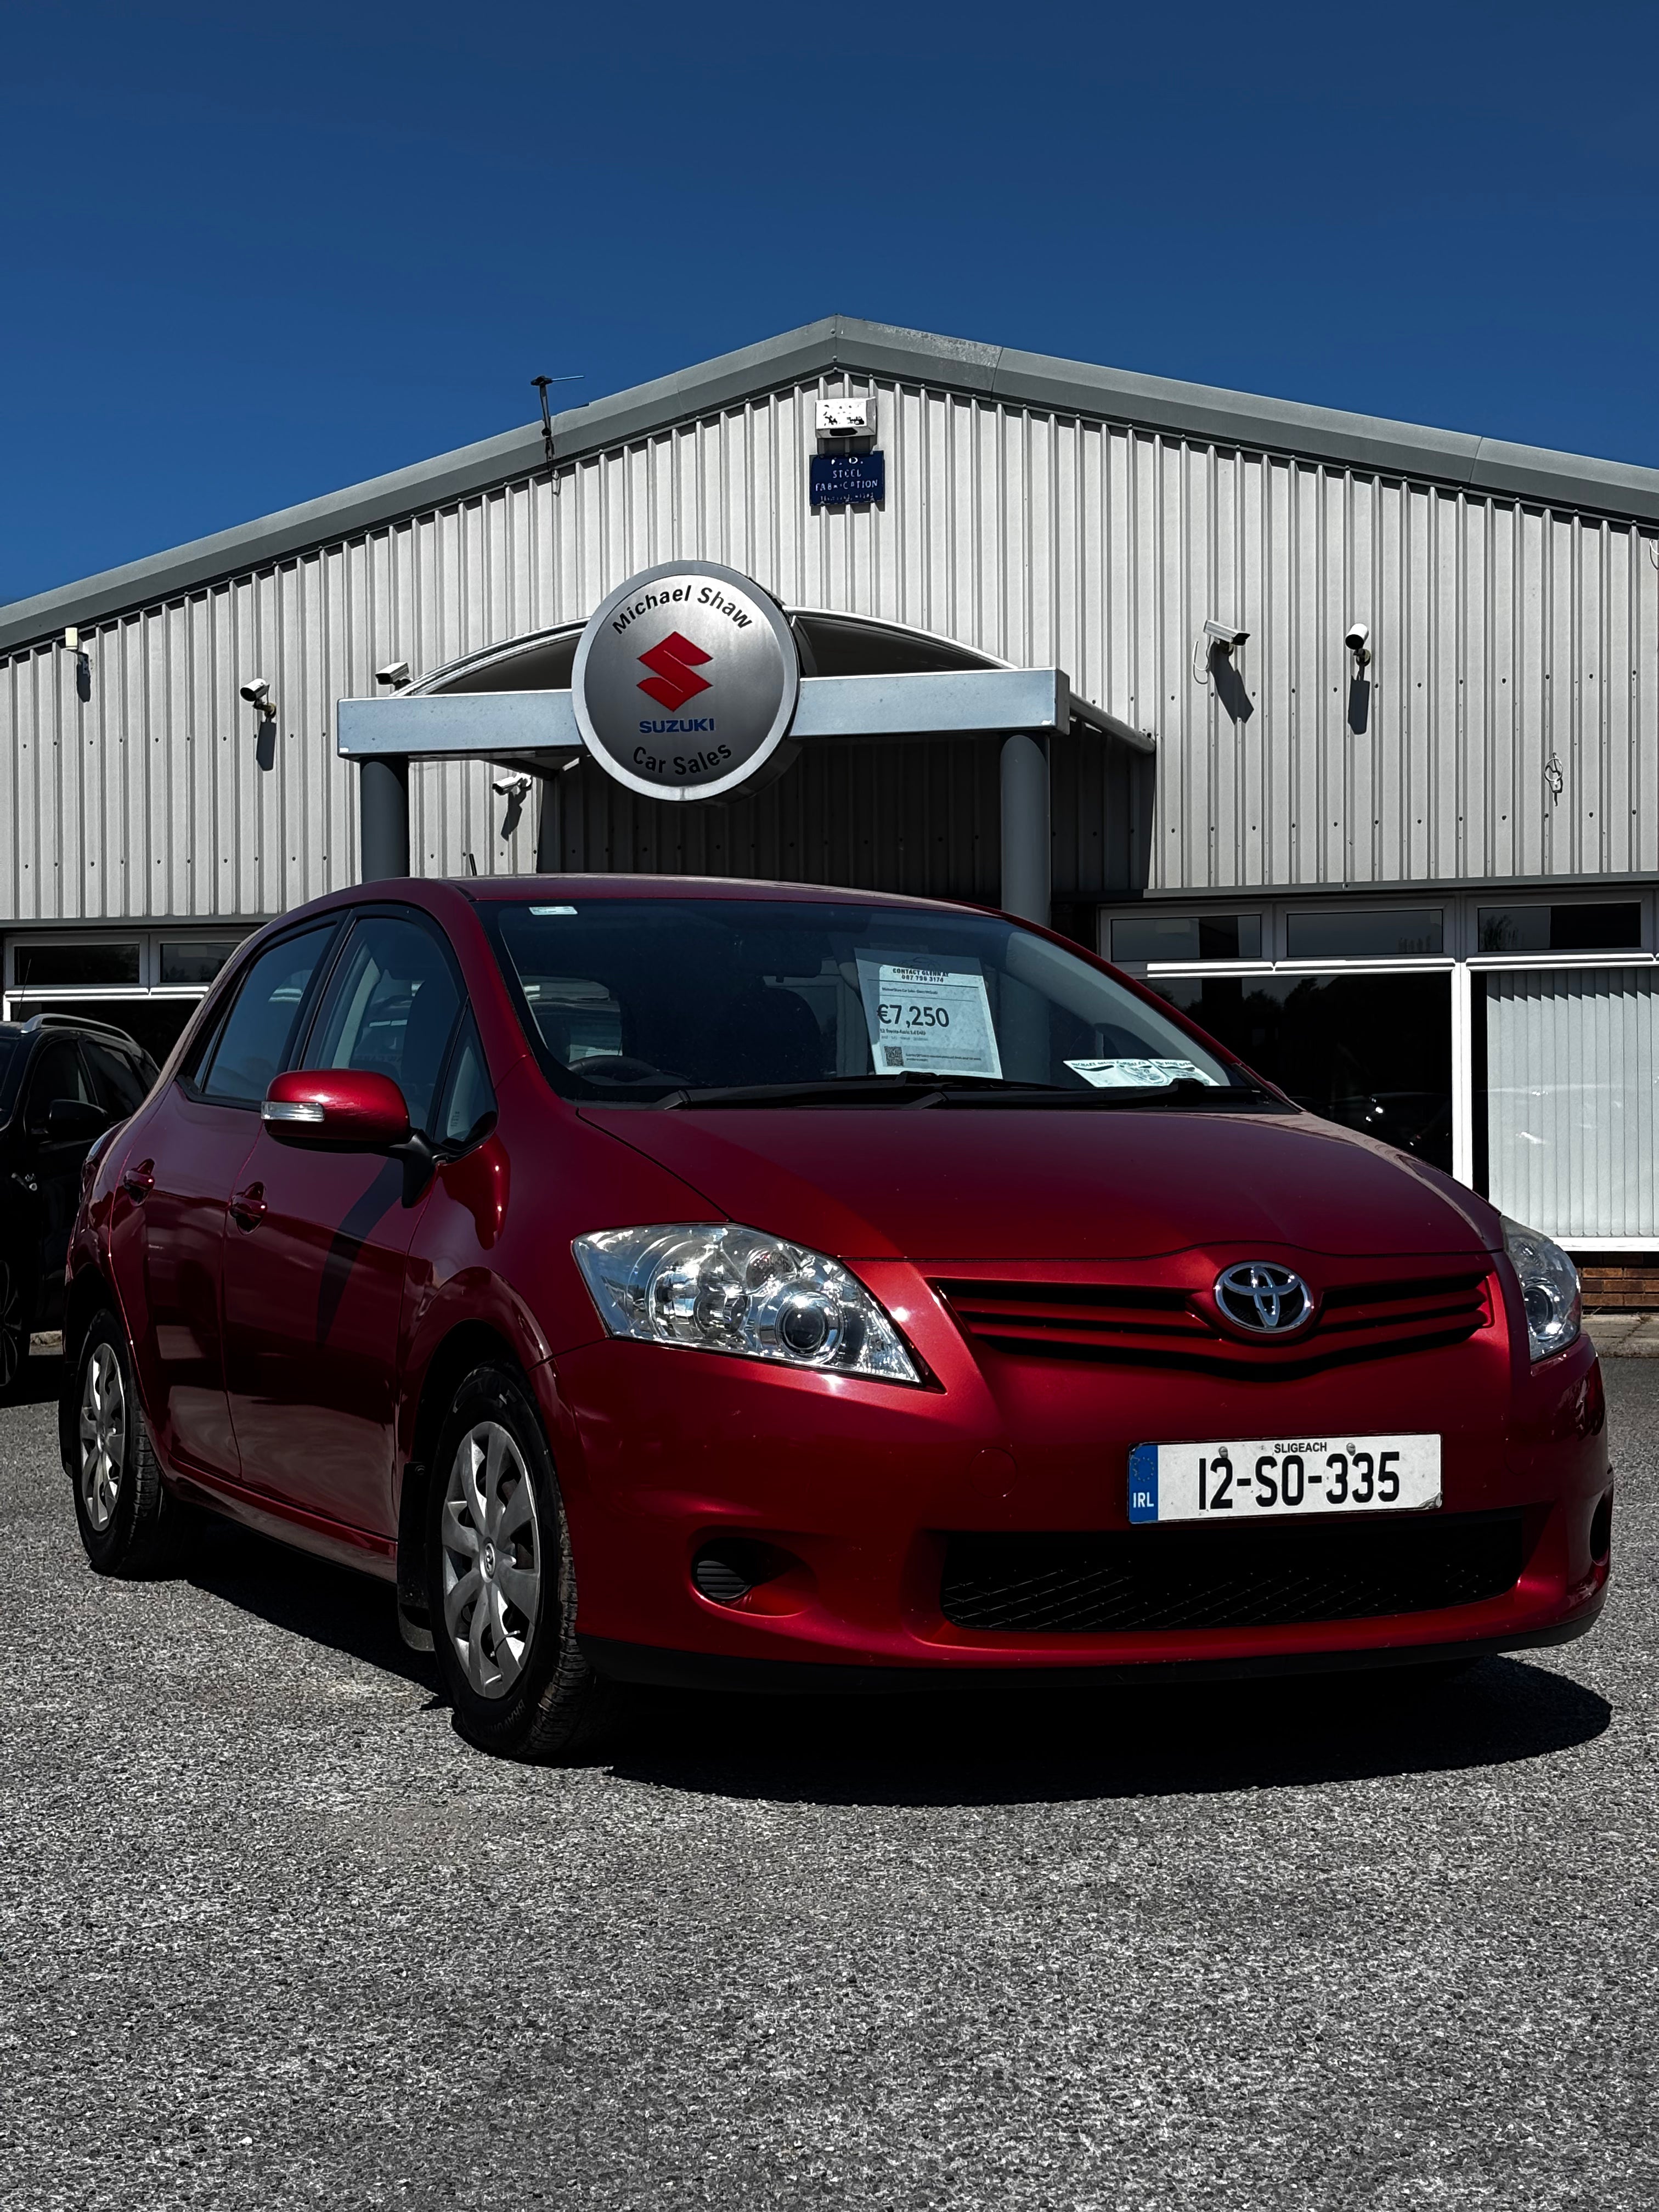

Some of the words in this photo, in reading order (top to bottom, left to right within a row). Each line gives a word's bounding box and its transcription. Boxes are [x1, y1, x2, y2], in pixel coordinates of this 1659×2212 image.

[611, 585, 691, 635] Michael
[697, 586, 753, 629] Shaw
[639, 718, 715, 733] SUZUKI
[633, 746, 666, 774] Car
[673, 744, 732, 775] Sales
[892, 968, 921, 976] CONTACT
[877, 1004, 950, 1028] €7,250
[1273, 1442, 1327, 1454] SLIGEACH
[1198, 1451, 1400, 1510] 12-SO-335
[1132, 1492, 1154, 1508] IRL
